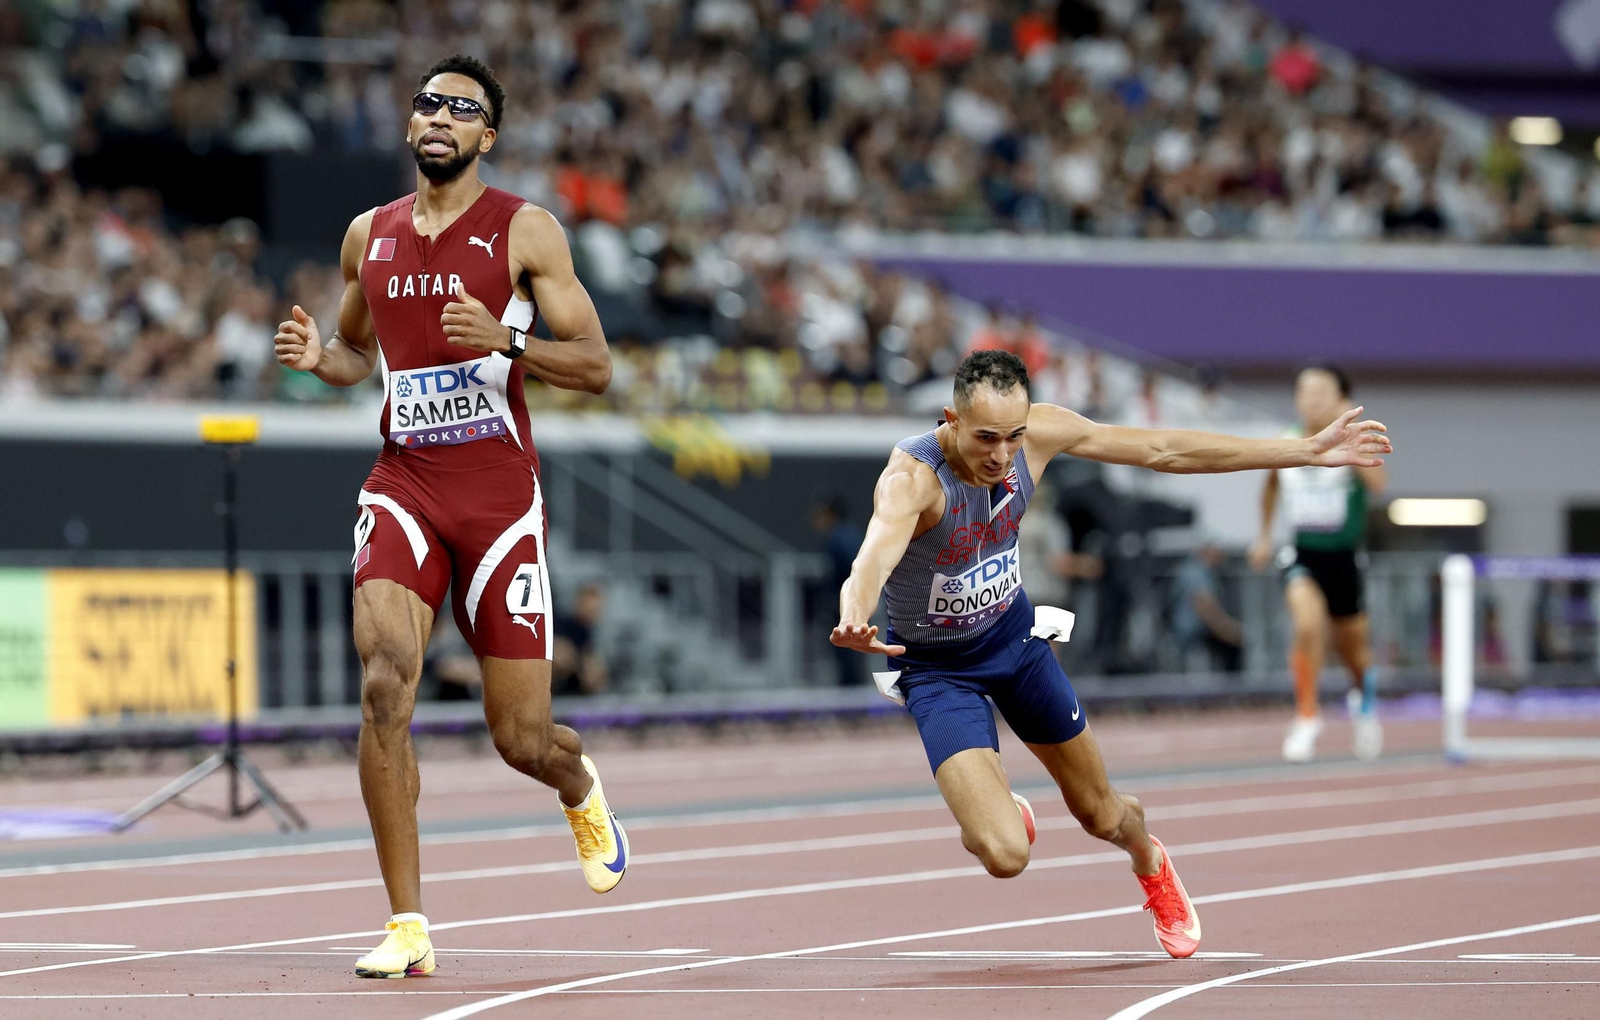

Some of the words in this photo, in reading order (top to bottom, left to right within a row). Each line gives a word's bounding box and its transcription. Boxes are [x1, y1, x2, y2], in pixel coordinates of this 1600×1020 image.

[387, 273, 461, 299] QATAR
[410, 363, 487, 396] TDK
[397, 392, 495, 428] SAMBA
[935, 513, 1021, 566] BRAIN
[963, 548, 1017, 590] TDK
[515, 573, 533, 607] 7
[934, 566, 1018, 614] DONOVAN
